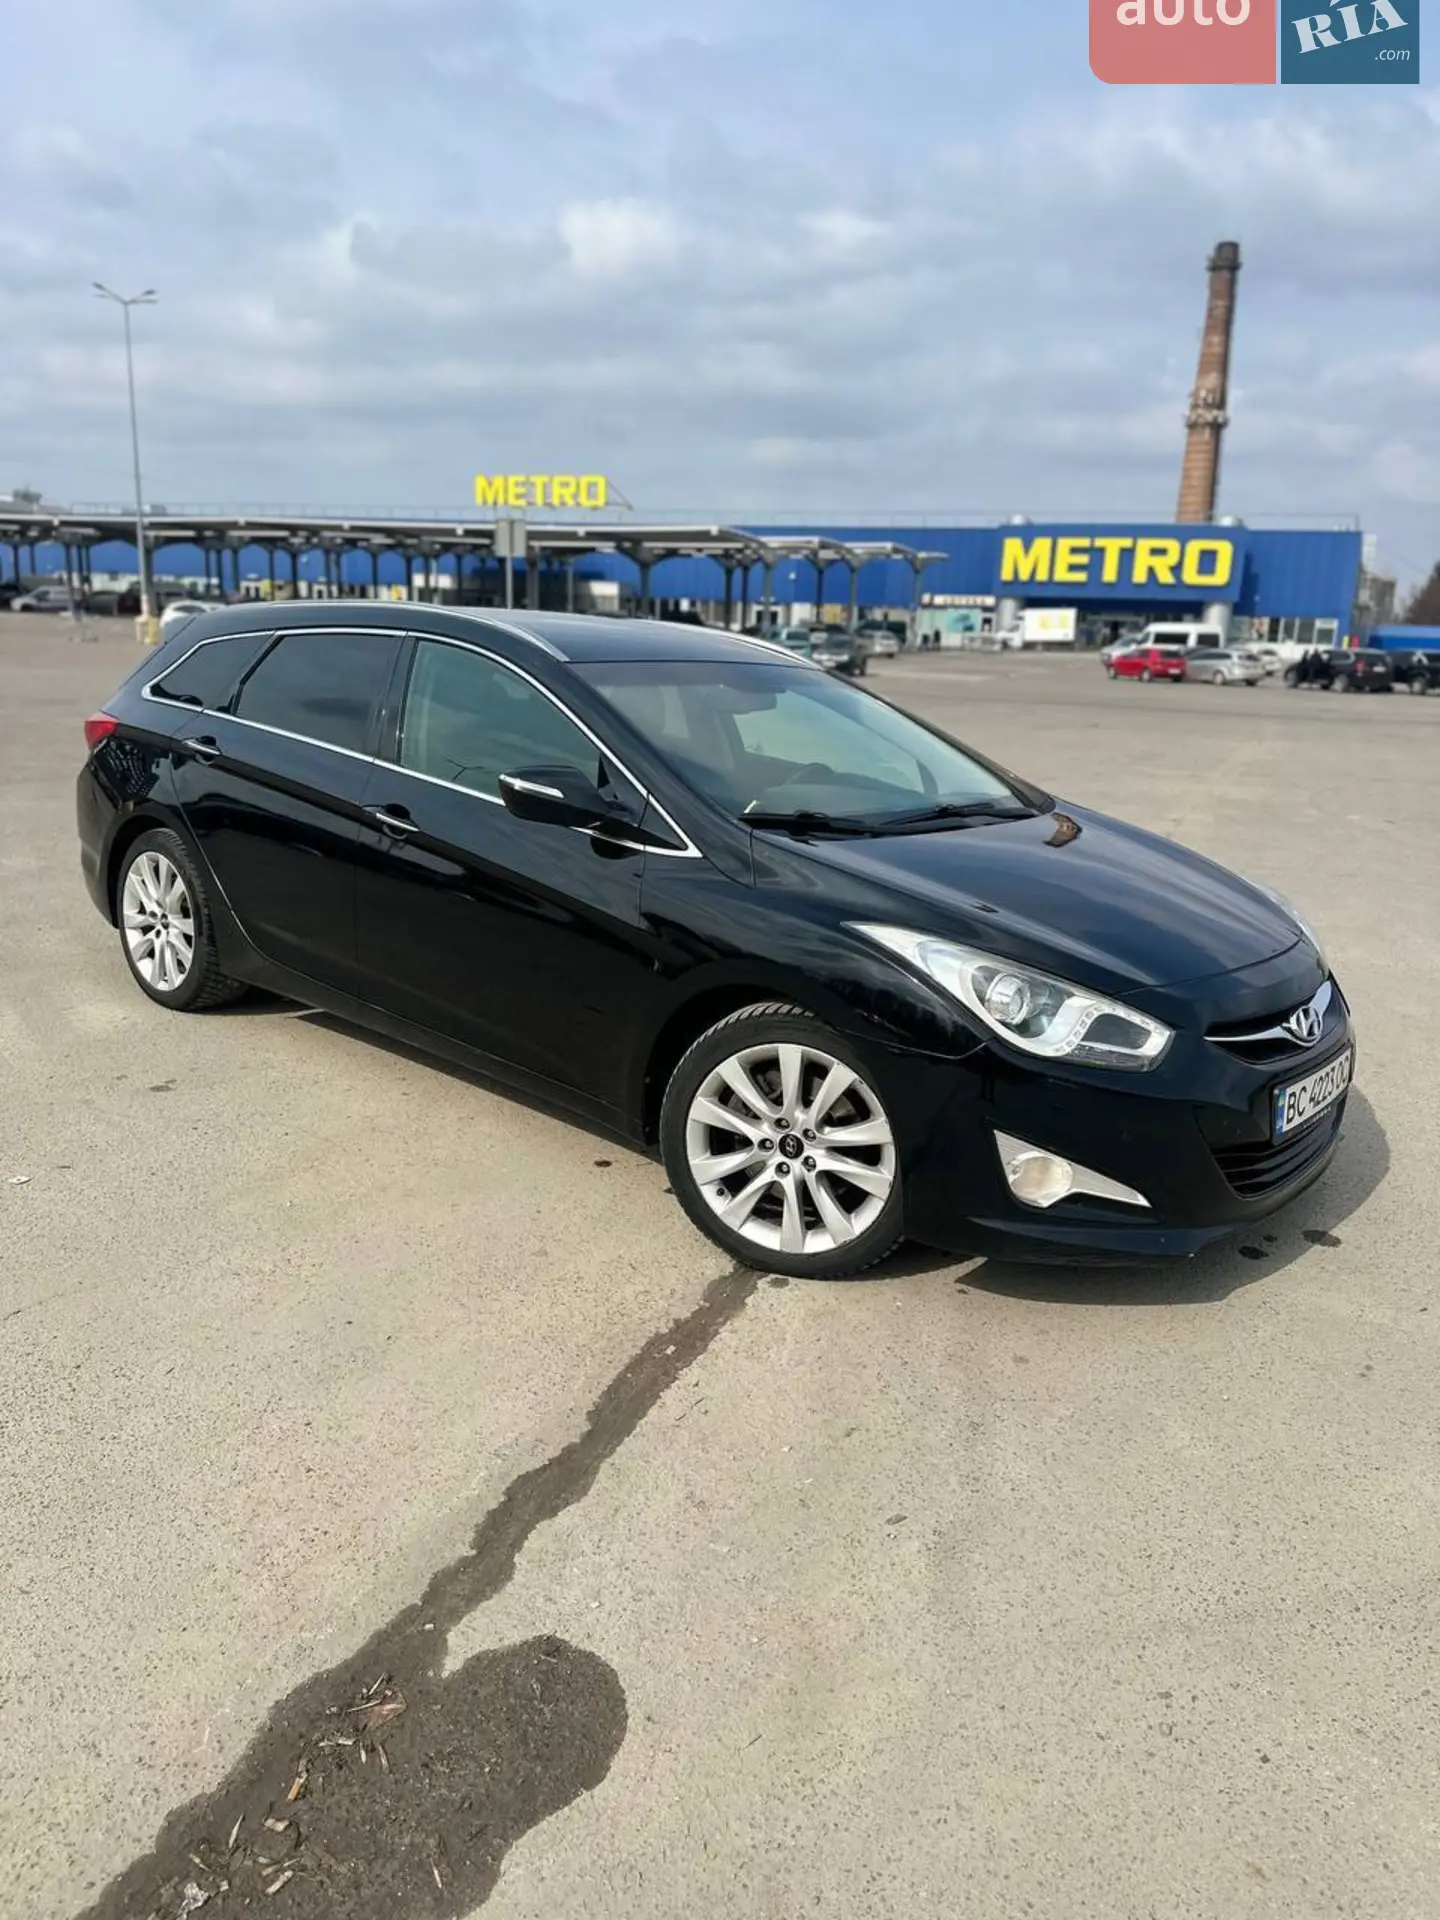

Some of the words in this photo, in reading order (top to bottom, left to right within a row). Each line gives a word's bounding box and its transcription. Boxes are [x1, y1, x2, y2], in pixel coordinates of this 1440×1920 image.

[475, 475, 606, 507] METRO
[1000, 537, 1233, 586] METRO
[1286, 1086, 1307, 1125] BC
